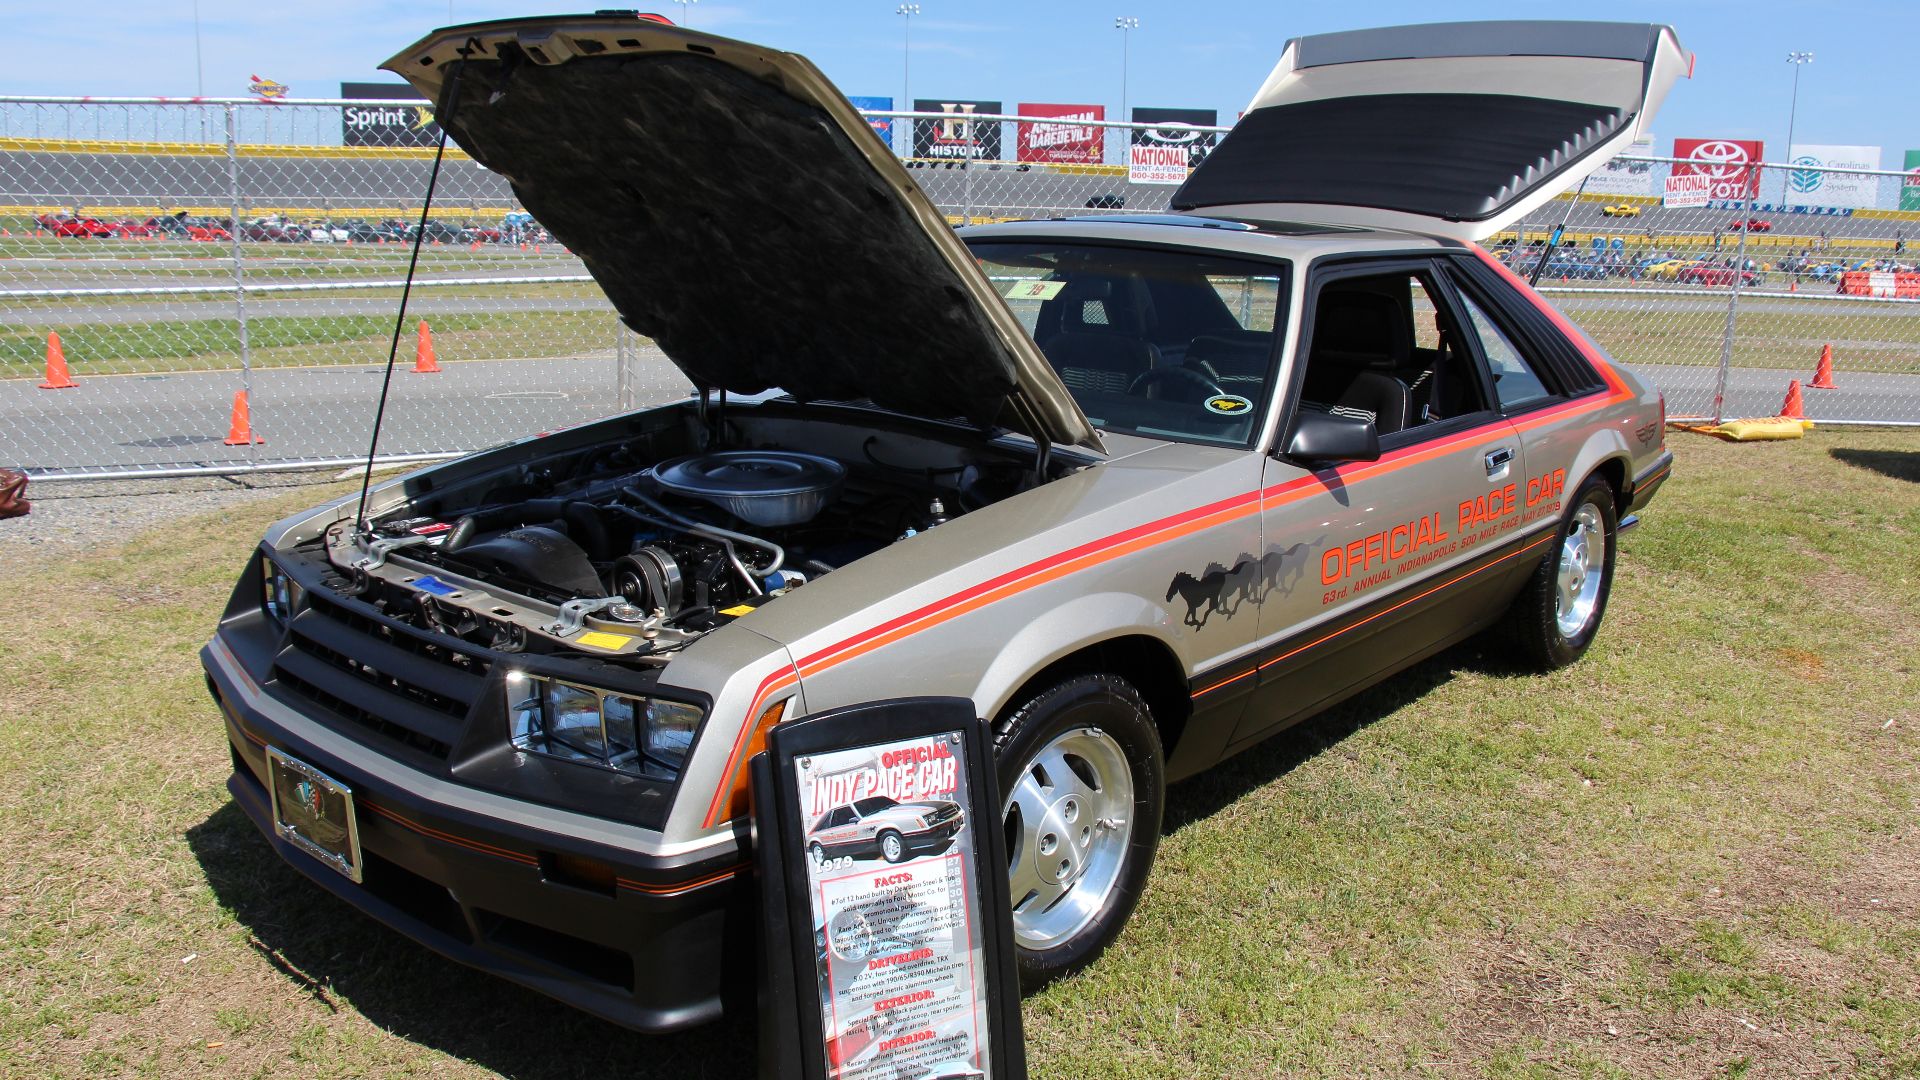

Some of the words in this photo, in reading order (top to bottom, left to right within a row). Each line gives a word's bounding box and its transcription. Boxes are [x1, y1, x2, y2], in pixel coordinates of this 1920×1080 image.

[345, 107, 406, 130] Sprint
[1131, 148, 1187, 167] NATIONAL
[1131, 165, 1186, 173] RENT-A-FENCE
[1131, 172, 1186, 180] 800-352-5675
[1665, 177, 1708, 193] NATIONAL
[1321, 511, 1449, 586] OFFICIAL
[1457, 482, 1517, 534] PACE
[1525, 467, 1566, 508] CAR
[1353, 571, 1392, 593] ANNUAL
[1396, 544, 1457, 575] INDIANAPOLIS
[1460, 536, 1478, 550] 500
[1479, 527, 1498, 543] MILE
[1500, 517, 1519, 532] RACE
[881, 743, 954, 769] OFFICIAL
[811, 772, 862, 817] INDY
[863, 760, 914, 801] PACE
[917, 756, 960, 798] CAR
[814, 855, 854, 874] 1979
[855, 891, 870, 900] hand
[871, 889, 884, 897] built
[886, 887, 893, 895] by
[922, 878, 937, 886] Steel
[874, 872, 913, 889] FACTS:
[842, 904, 856, 912] Sold
[857, 898, 884, 910] internally
[893, 893, 906, 901] Ford
[907, 889, 925, 898] Motor
[949, 888, 963, 898] 30
[864, 905, 899, 919] promotional
[877, 914, 898, 925] Unique
[930, 914, 943, 922] Pace
[835, 944, 851, 952] Used
[868, 947, 934, 971] DRIVELINE:
[838, 983, 870, 996] suspension
[925, 964, 950, 974] Michelin
[888, 966, 905, 975] speed
[863, 989, 883, 999] forged
[934, 973, 953, 981] wheels
[873, 989, 935, 1012] EXTERIOR:
[847, 1016, 868, 1027] Special
[865, 1024, 875, 1032] fog
[895, 1015, 909, 1023] hood
[893, 1026, 908, 1034] open
[878, 1029, 937, 1052] INTERIOR:
[894, 1045, 914, 1056] bucket
[938, 1033, 968, 1046] checkered
[870, 1061, 896, 1073] premium
[916, 1050, 928, 1059] with
[944, 1049, 969, 1060] wrapped
[913, 1068, 931, 1078] wheel
